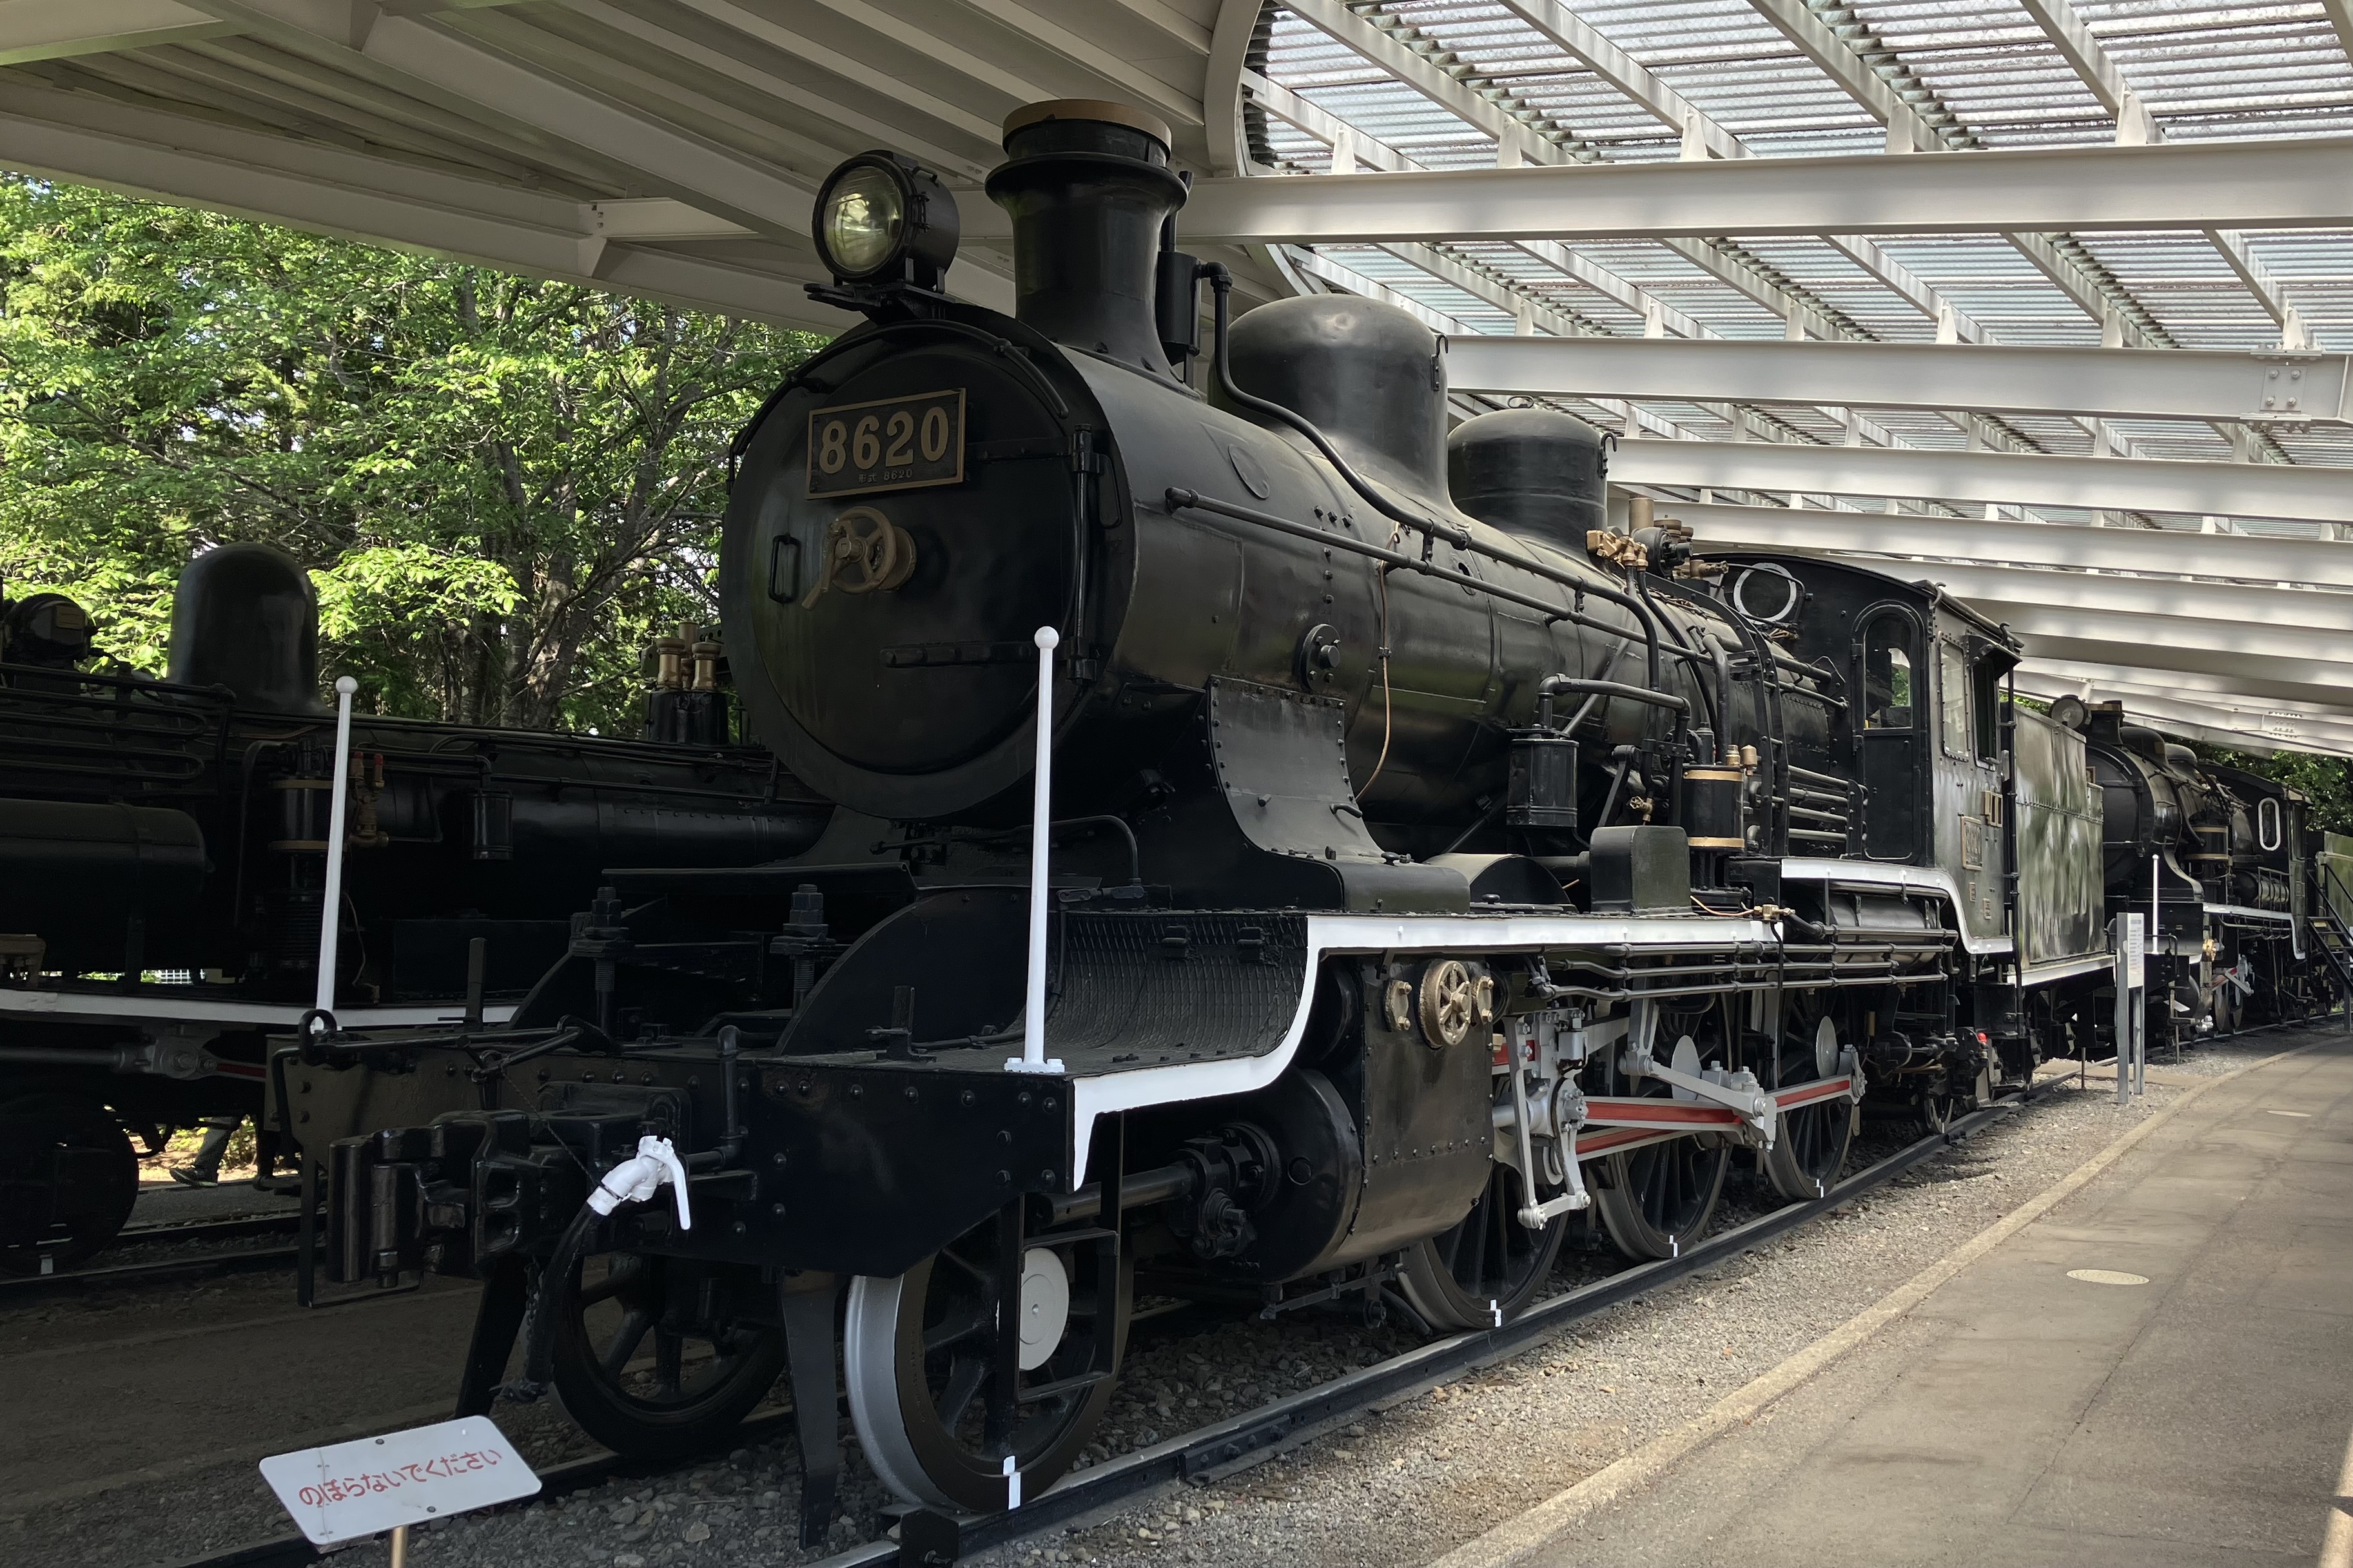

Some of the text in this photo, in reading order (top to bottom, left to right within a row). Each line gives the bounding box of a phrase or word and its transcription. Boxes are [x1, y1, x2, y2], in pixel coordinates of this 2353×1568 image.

[819, 406, 949, 474] 8620
[858, 468, 912, 483] 形式 8620
[298, 1449, 502, 1505] のぼらないでください
